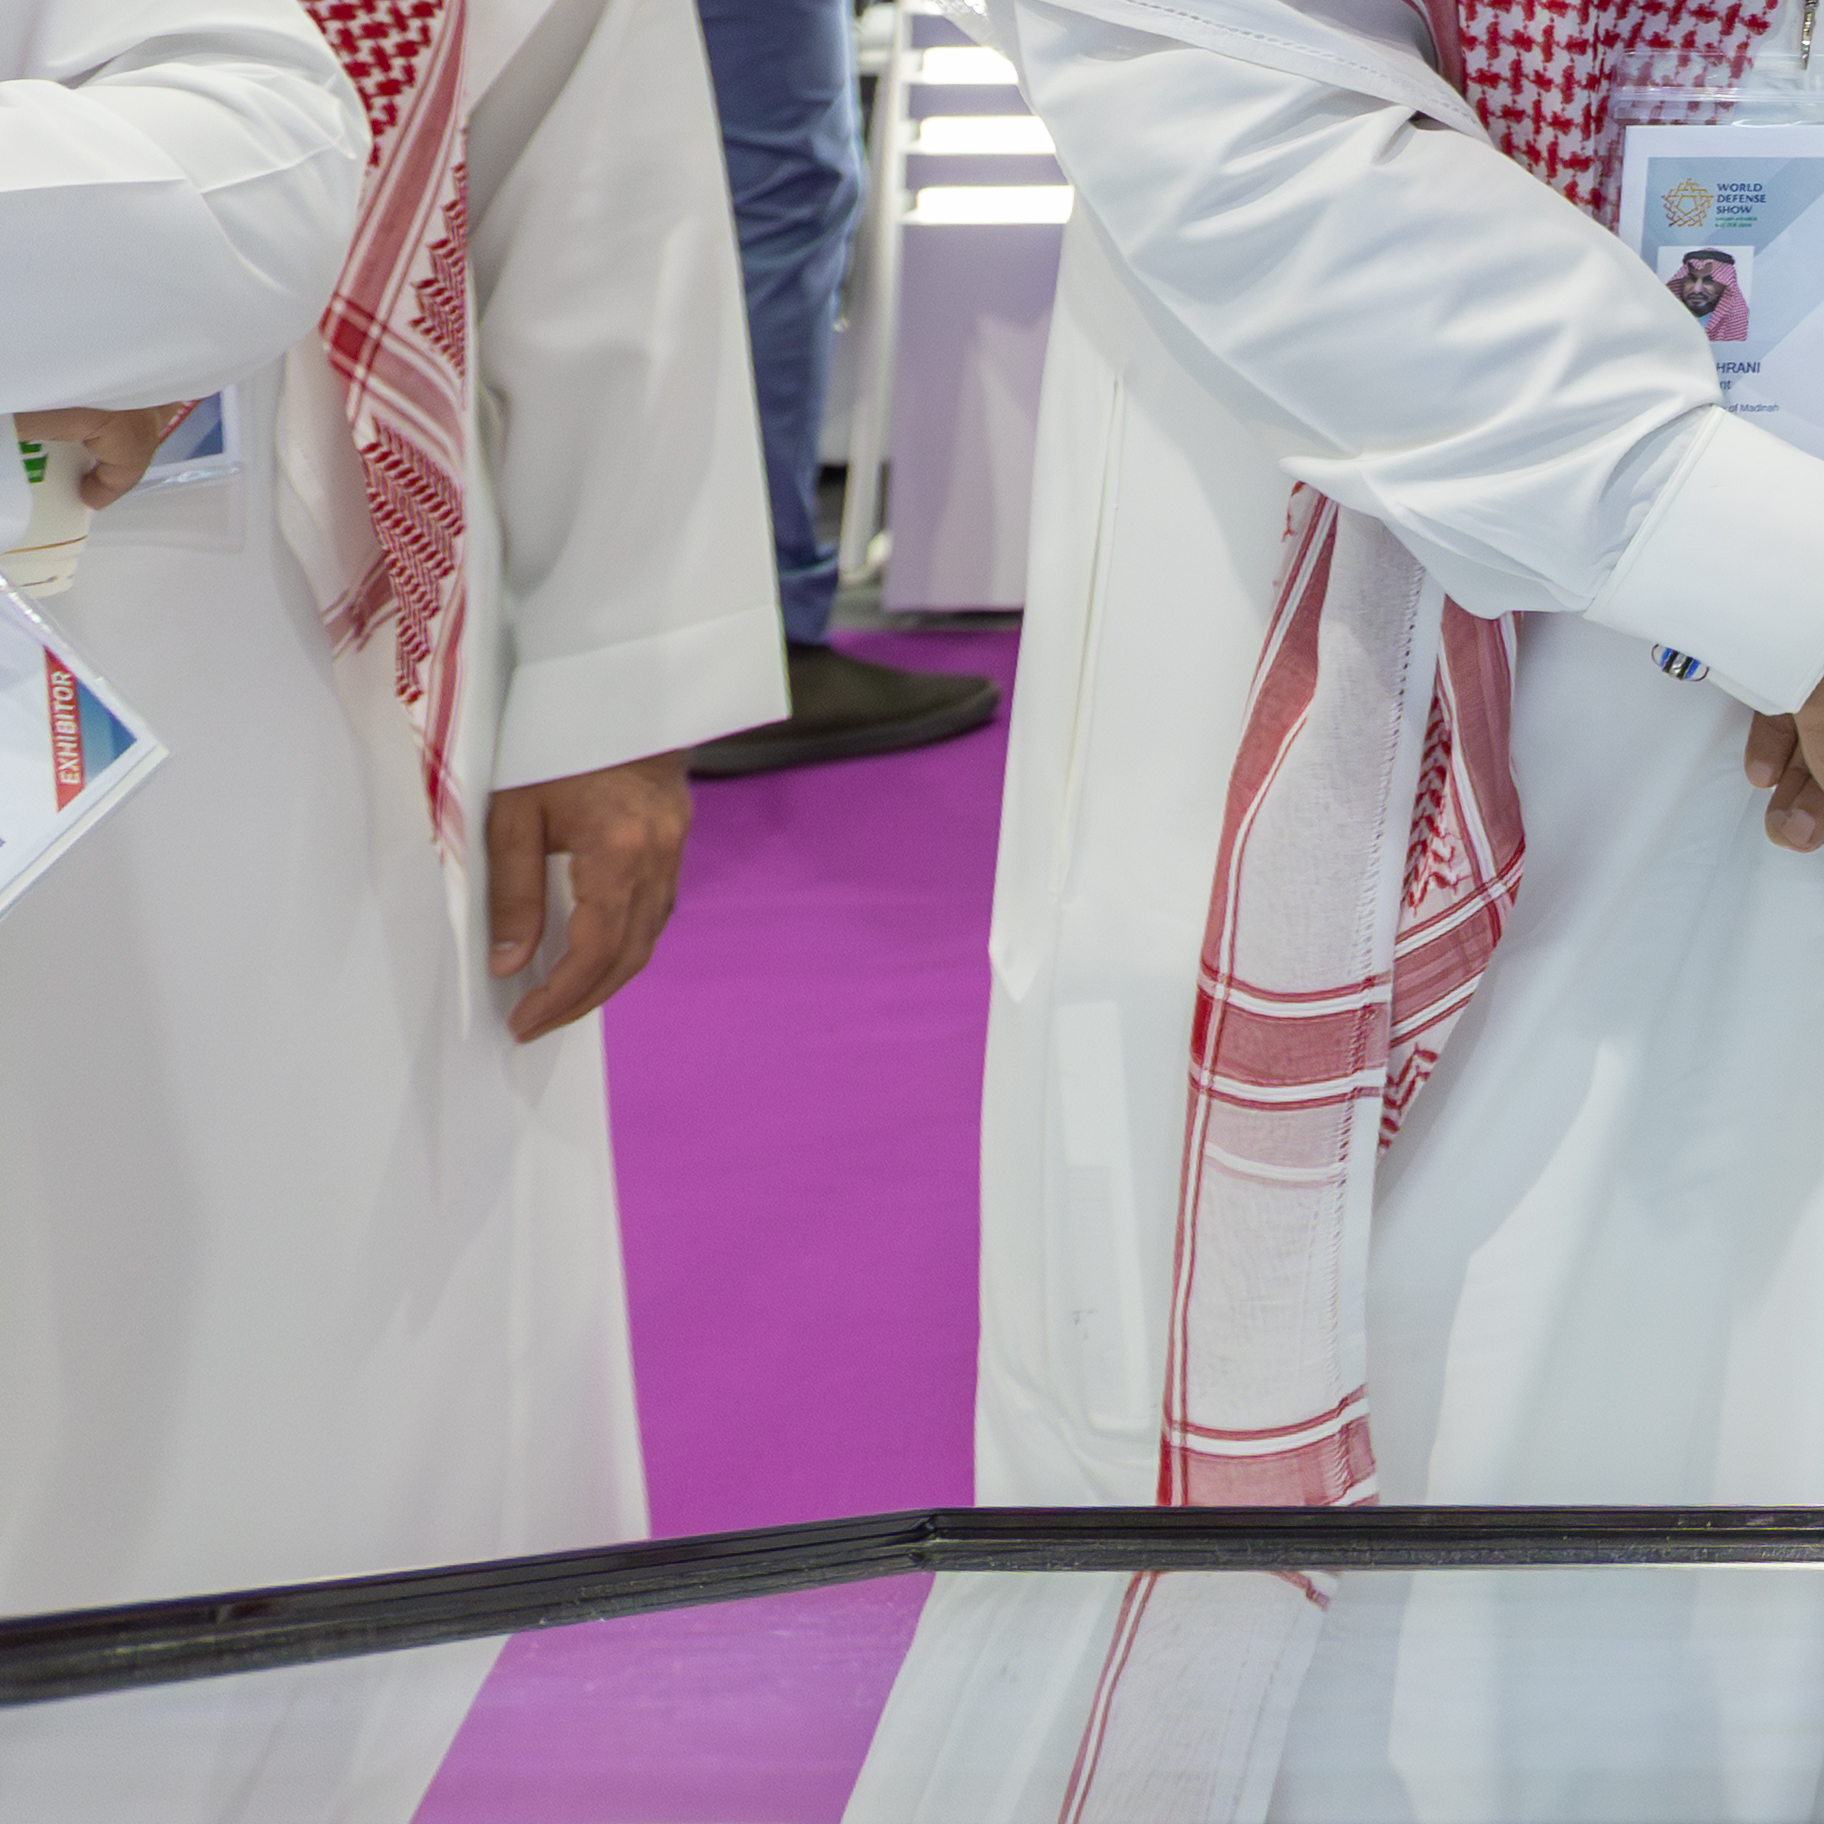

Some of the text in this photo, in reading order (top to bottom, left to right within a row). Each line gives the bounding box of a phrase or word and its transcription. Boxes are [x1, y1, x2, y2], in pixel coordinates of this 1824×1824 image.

[1716, 182, 1763, 193] WORLD
[1716, 193, 1767, 204] DEFENSE
[1715, 205, 1754, 215] SHOW
[51, 670, 82, 785] EXHIBITOR
